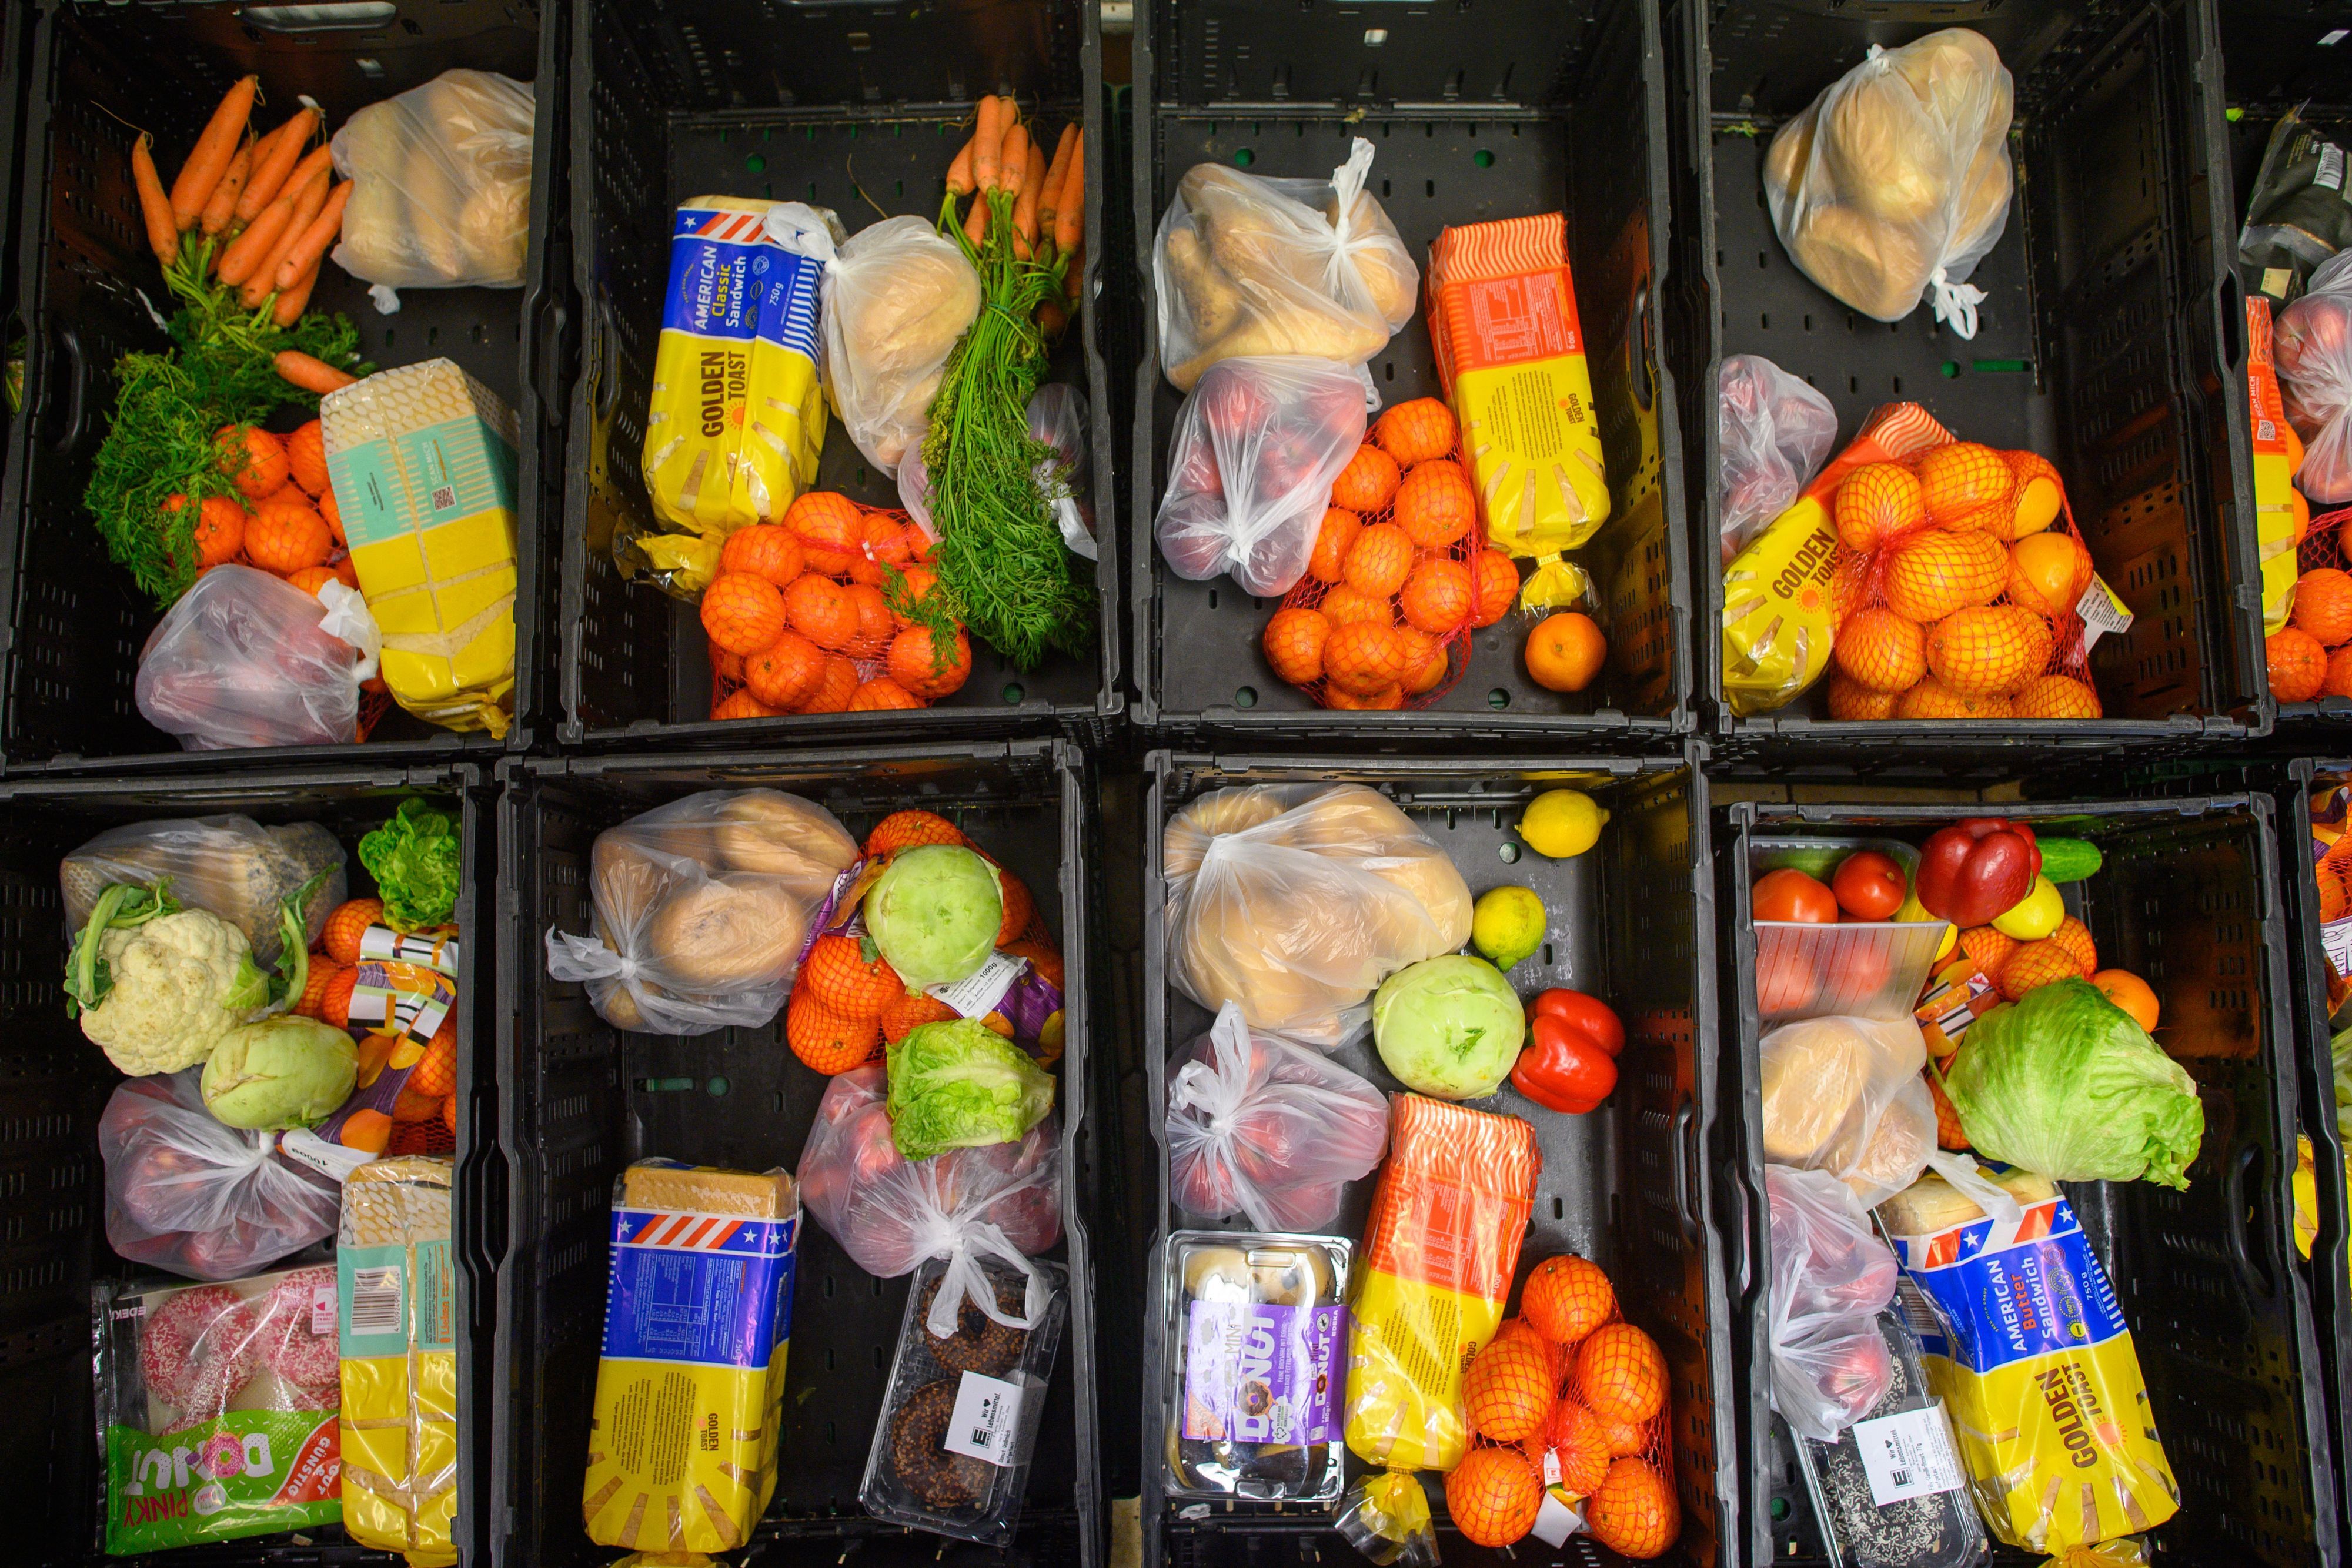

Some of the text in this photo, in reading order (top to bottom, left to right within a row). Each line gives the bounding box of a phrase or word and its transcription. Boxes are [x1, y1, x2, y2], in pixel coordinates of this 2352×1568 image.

[694, 246, 717, 330] AMERICAN
[711, 263, 730, 316] Classic
[726, 255, 746, 327] Sandwich
[769, 288, 781, 306] 750
[728, 350, 745, 400] TOAST
[701, 352, 724, 436] GOLDEN
[1568, 393, 1585, 423] GOLDEN
[2251, 399, 2261, 416] SCAN
[1565, 407, 1576, 424] TOAST
[421, 441, 432, 463] MICH
[427, 464, 438, 486] SCAN
[1770, 527, 1835, 600] GOLDEN
[979, 961, 997, 979] 1000g
[1493, 1273, 1501, 1288] 500
[2021, 1256, 2054, 1338] Sandwich
[2083, 1281, 2093, 1300] 750
[440, 1300, 449, 1334] Lieken
[1987, 1259, 2027, 1350] AMERICAN
[2010, 1274, 2036, 1330] Butter
[1225, 1324, 1241, 1353] MINI
[1310, 1343, 1319, 1361] MINI
[2061, 1363, 2102, 1420] TOAST
[981, 1408, 989, 1417] Wir
[986, 1392, 1001, 1427] Lebensmittel.
[2034, 1368, 2097, 1466] GOLDEN
[707, 1413, 718, 1451] GOLDEN
[971, 1429, 987, 1445] E
[286, 1436, 332, 1497] GÜNSTIG
[313, 1464, 326, 1477] &
[315, 1463, 340, 1495] GUT
[121, 1489, 189, 1527] PINKY
